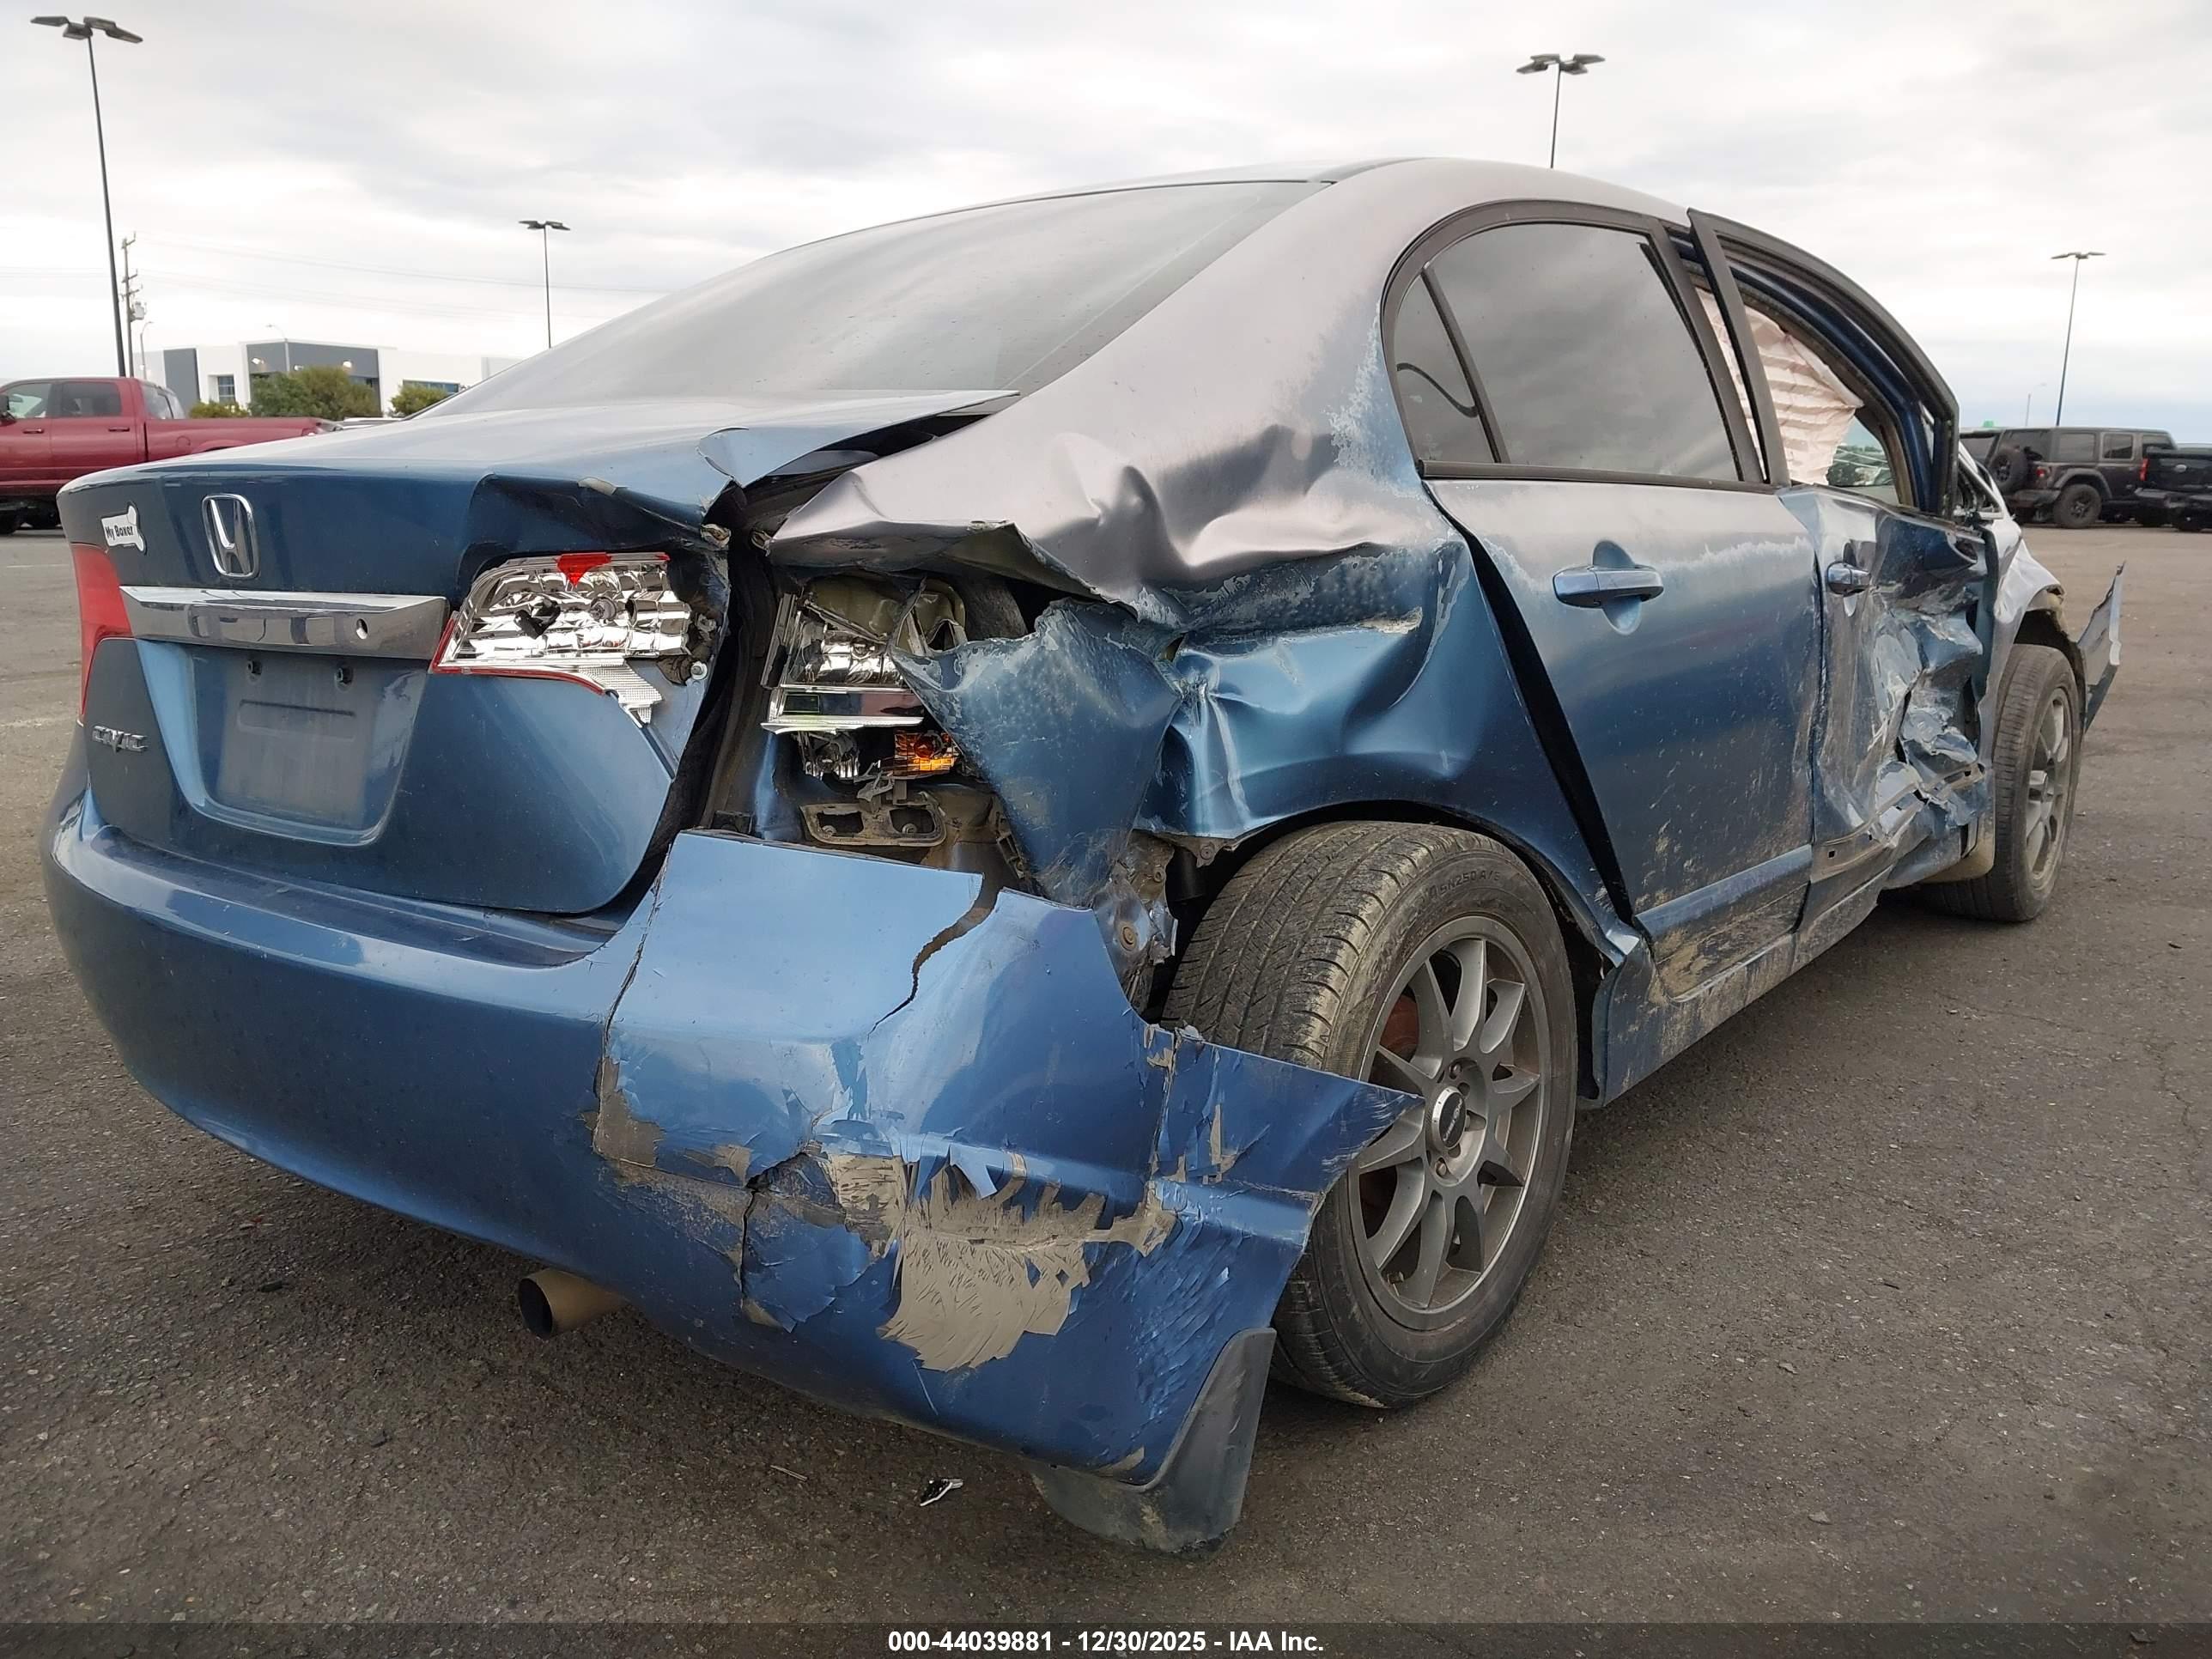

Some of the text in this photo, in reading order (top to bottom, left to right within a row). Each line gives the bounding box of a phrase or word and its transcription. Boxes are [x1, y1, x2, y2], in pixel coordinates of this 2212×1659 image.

[105, 525, 134, 541] My Boxer
[92, 725, 149, 755] CIVIC
